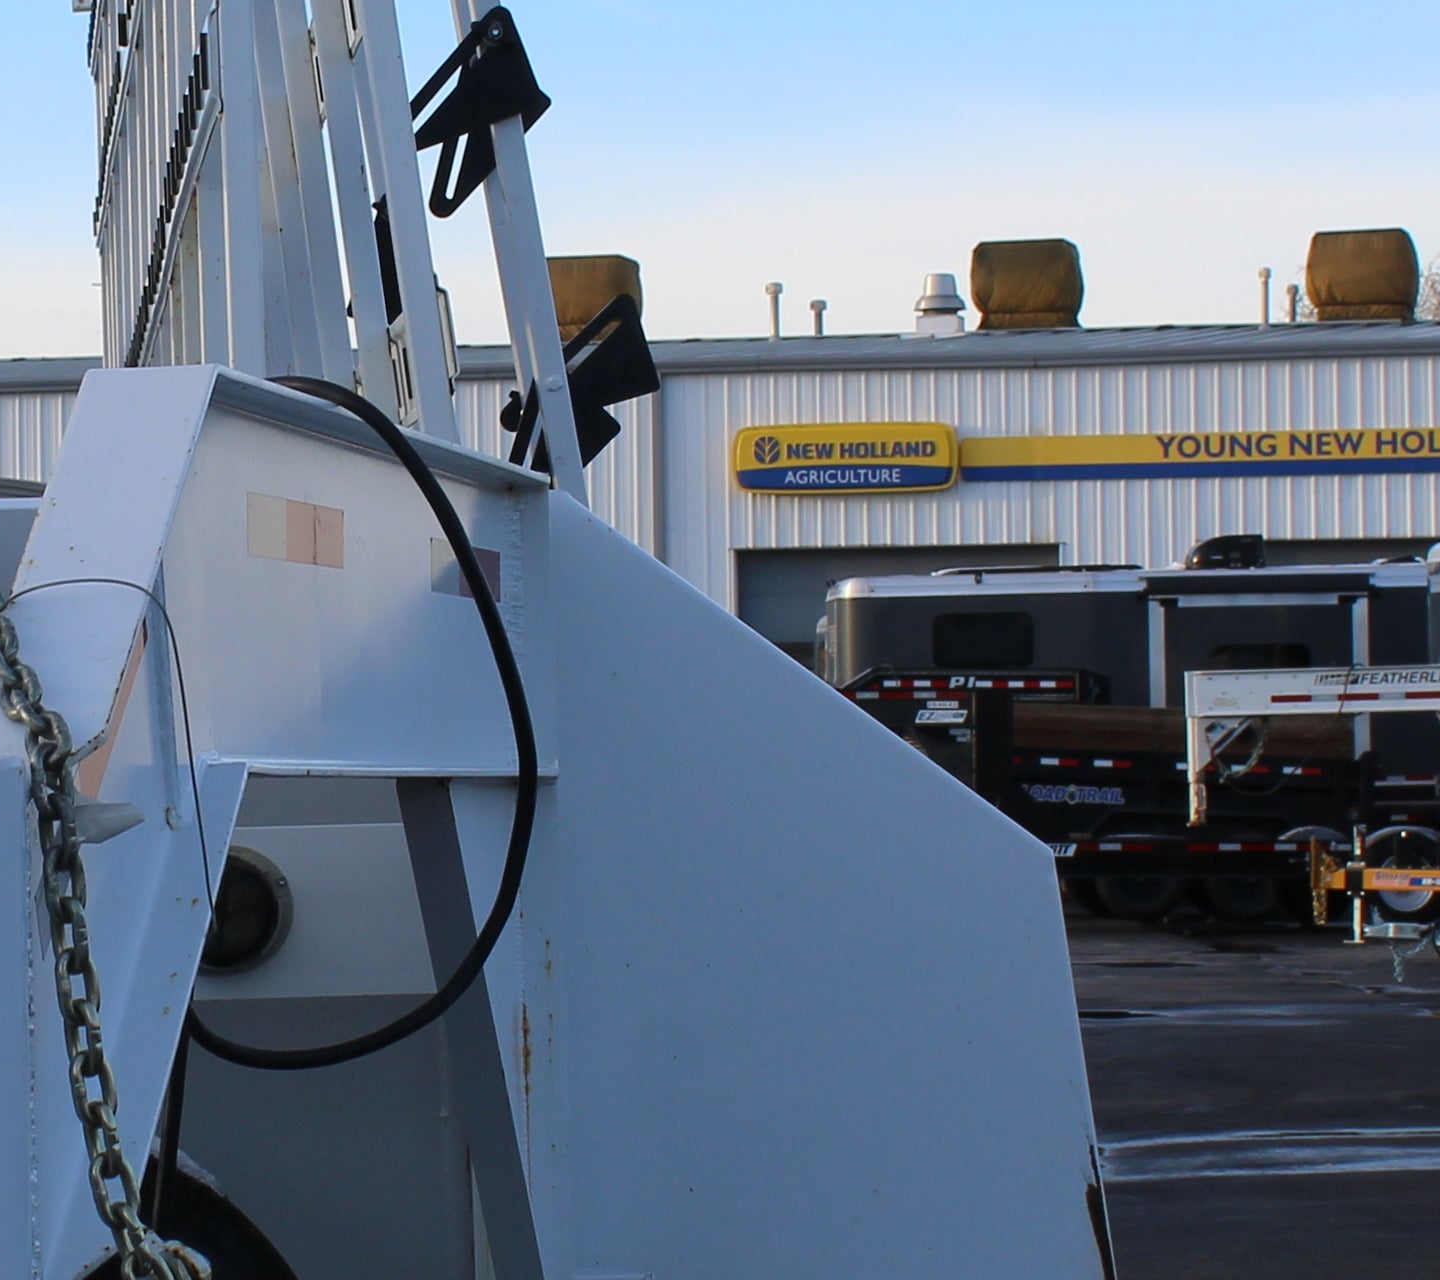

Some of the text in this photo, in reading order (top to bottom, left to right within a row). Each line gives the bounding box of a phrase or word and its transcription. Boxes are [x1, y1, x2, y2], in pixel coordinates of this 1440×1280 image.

[786, 440, 937, 460] NEW HOLLAND
[1155, 433, 1278, 458] YOUNG
[1289, 431, 1365, 457] NEW
[784, 468, 901, 484] AGRICULTURE
[1077, 786, 1125, 804] TRAIL
